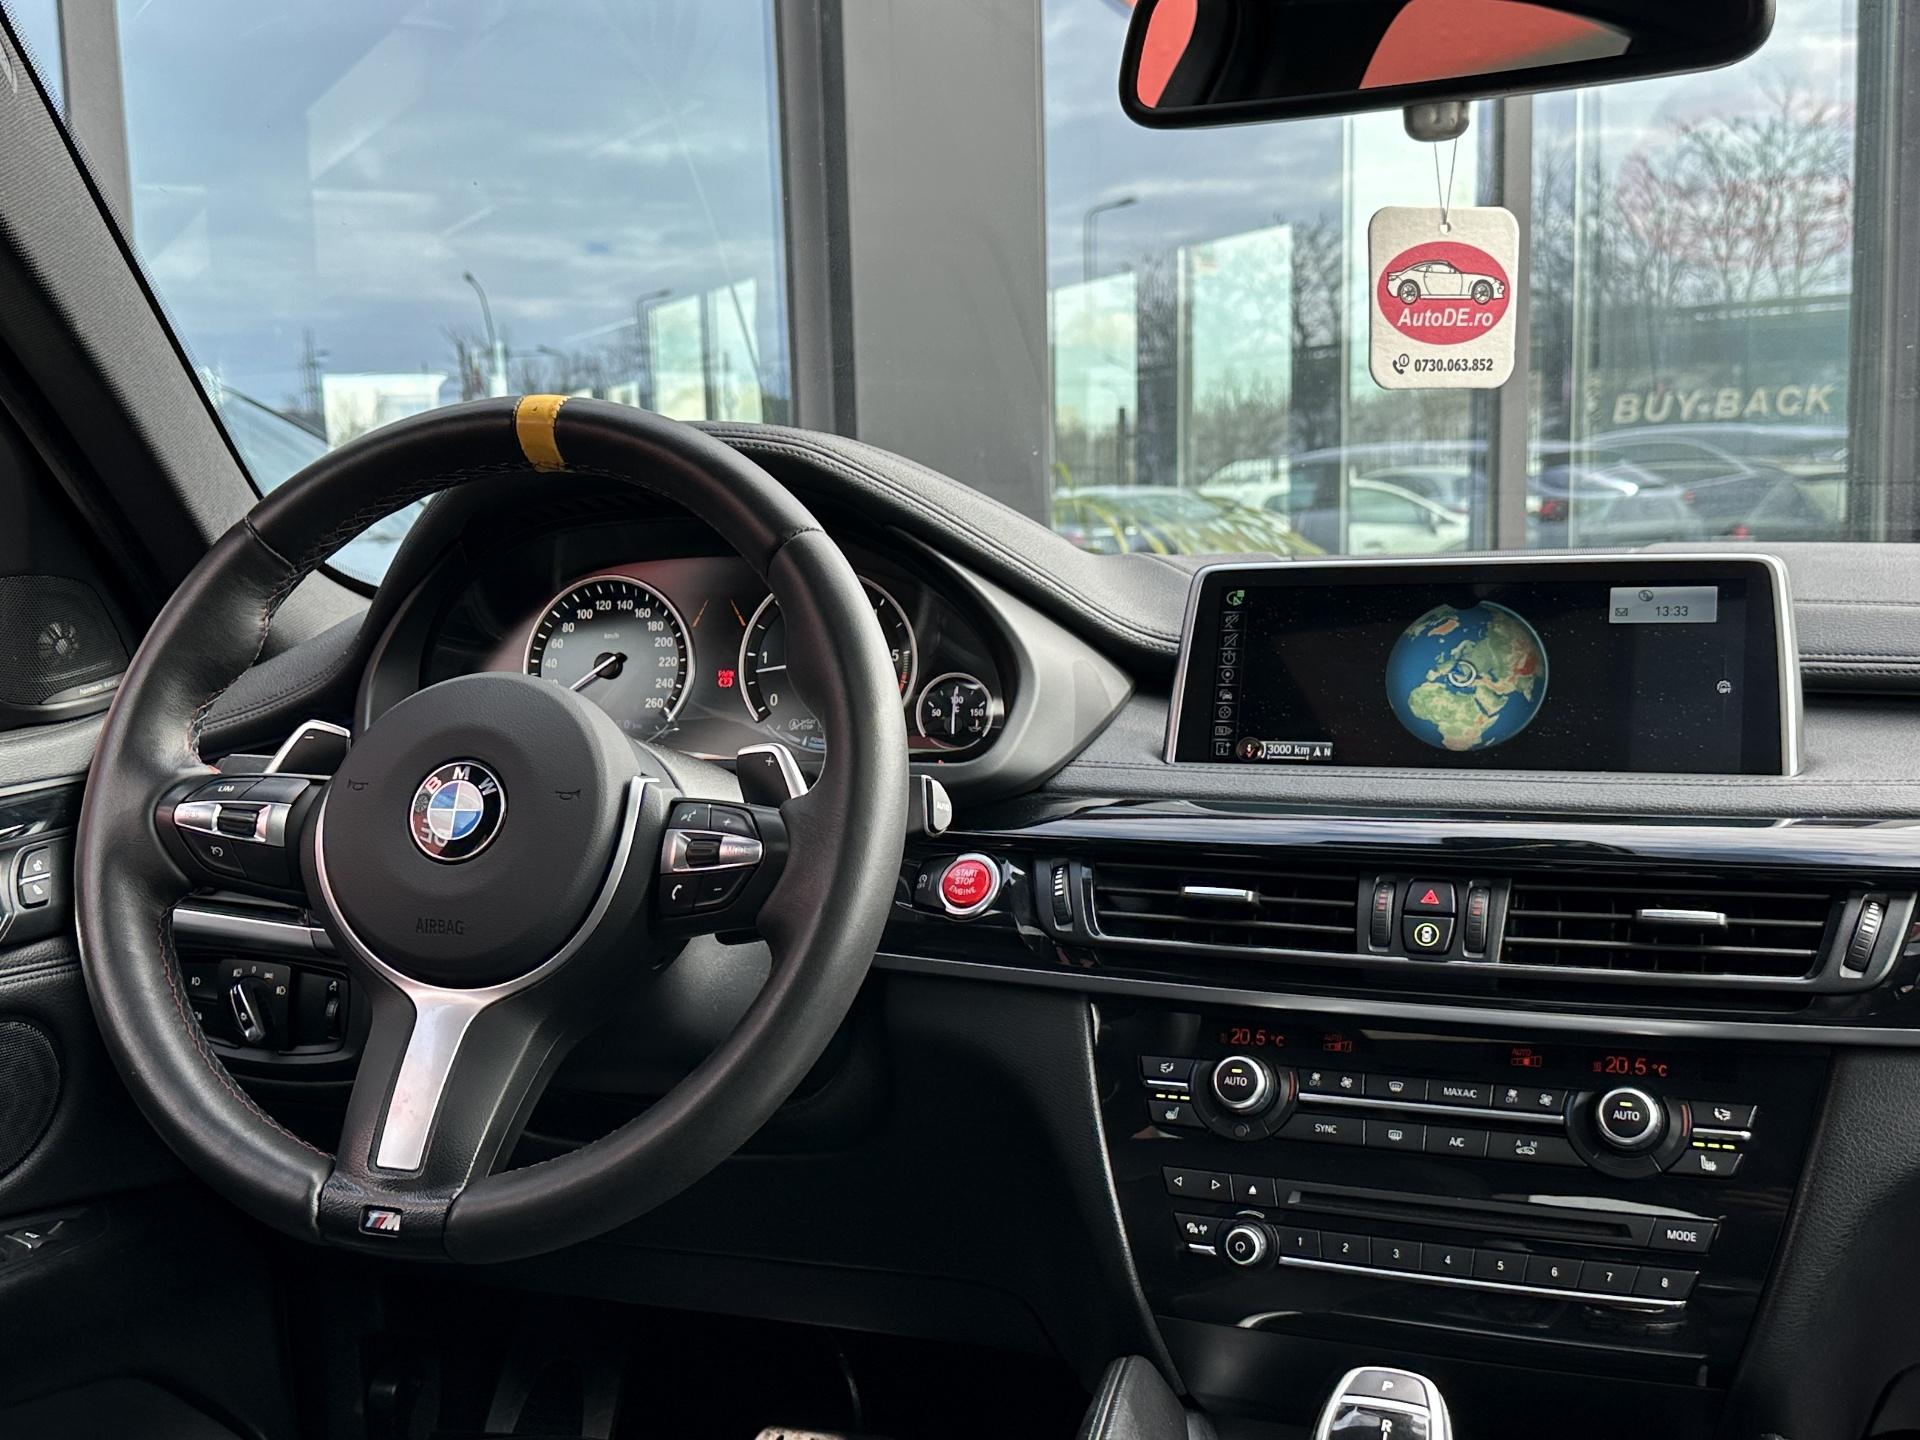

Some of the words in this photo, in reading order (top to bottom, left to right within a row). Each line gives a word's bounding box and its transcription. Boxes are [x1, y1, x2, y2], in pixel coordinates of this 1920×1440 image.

[1397, 308, 1494, 327] AutoDE.ro
[1414, 358, 1494, 372] 0730.063.852
[595, 600, 612, 611] 120
[616, 600, 634, 611] 140
[1655, 605, 1689, 617] 13:33
[576, 608, 594, 620] 100
[634, 608, 652, 619] 160
[561, 622, 575, 633] 80
[647, 620, 664, 632] 180
[551, 638, 564, 649] 60
[654, 636, 674, 648] 200
[761, 651, 768, 664] 1
[891, 648, 900, 662] 5
[544, 657, 558, 668] 40
[658, 656, 678, 668] 220
[655, 678, 675, 689] 240
[644, 697, 664, 709] 260
[770, 693, 779, 706] 0
[931, 708, 942, 717] 50
[970, 708, 984, 717] 150
[1267, 744, 1292, 755] 3000
[1294, 744, 1310, 755] km
[424, 765, 498, 797] BMW
[217, 784, 235, 793] LIM
[955, 867, 979, 878] START
[954, 877, 975, 886] STOP
[948, 885, 977, 896] ENGINE
[415, 917, 465, 936] AIRBAG
[1230, 1027, 1266, 1046] 20.5
[1605, 1056, 1647, 1076] 20.5
[1223, 1075, 1248, 1087] AUTO
[1612, 1109, 1641, 1122] AUTO
[1314, 1123, 1338, 1135] SYNC
[1448, 1136, 1465, 1147] A/C
[1297, 1236, 1303, 1247] 1
[1666, 1229, 1697, 1243] MODE
[1342, 1242, 1349, 1253] 2
[1392, 1248, 1400, 1259] 3
[1444, 1254, 1451, 1265] 4
[1497, 1260, 1504, 1271] 5
[1551, 1266, 1558, 1278] 6
[1606, 1272, 1614, 1282] 7
[1661, 1277, 1668, 1288] 8
[1381, 1380, 1394, 1392] P
[1380, 1418, 1393, 1433] R
